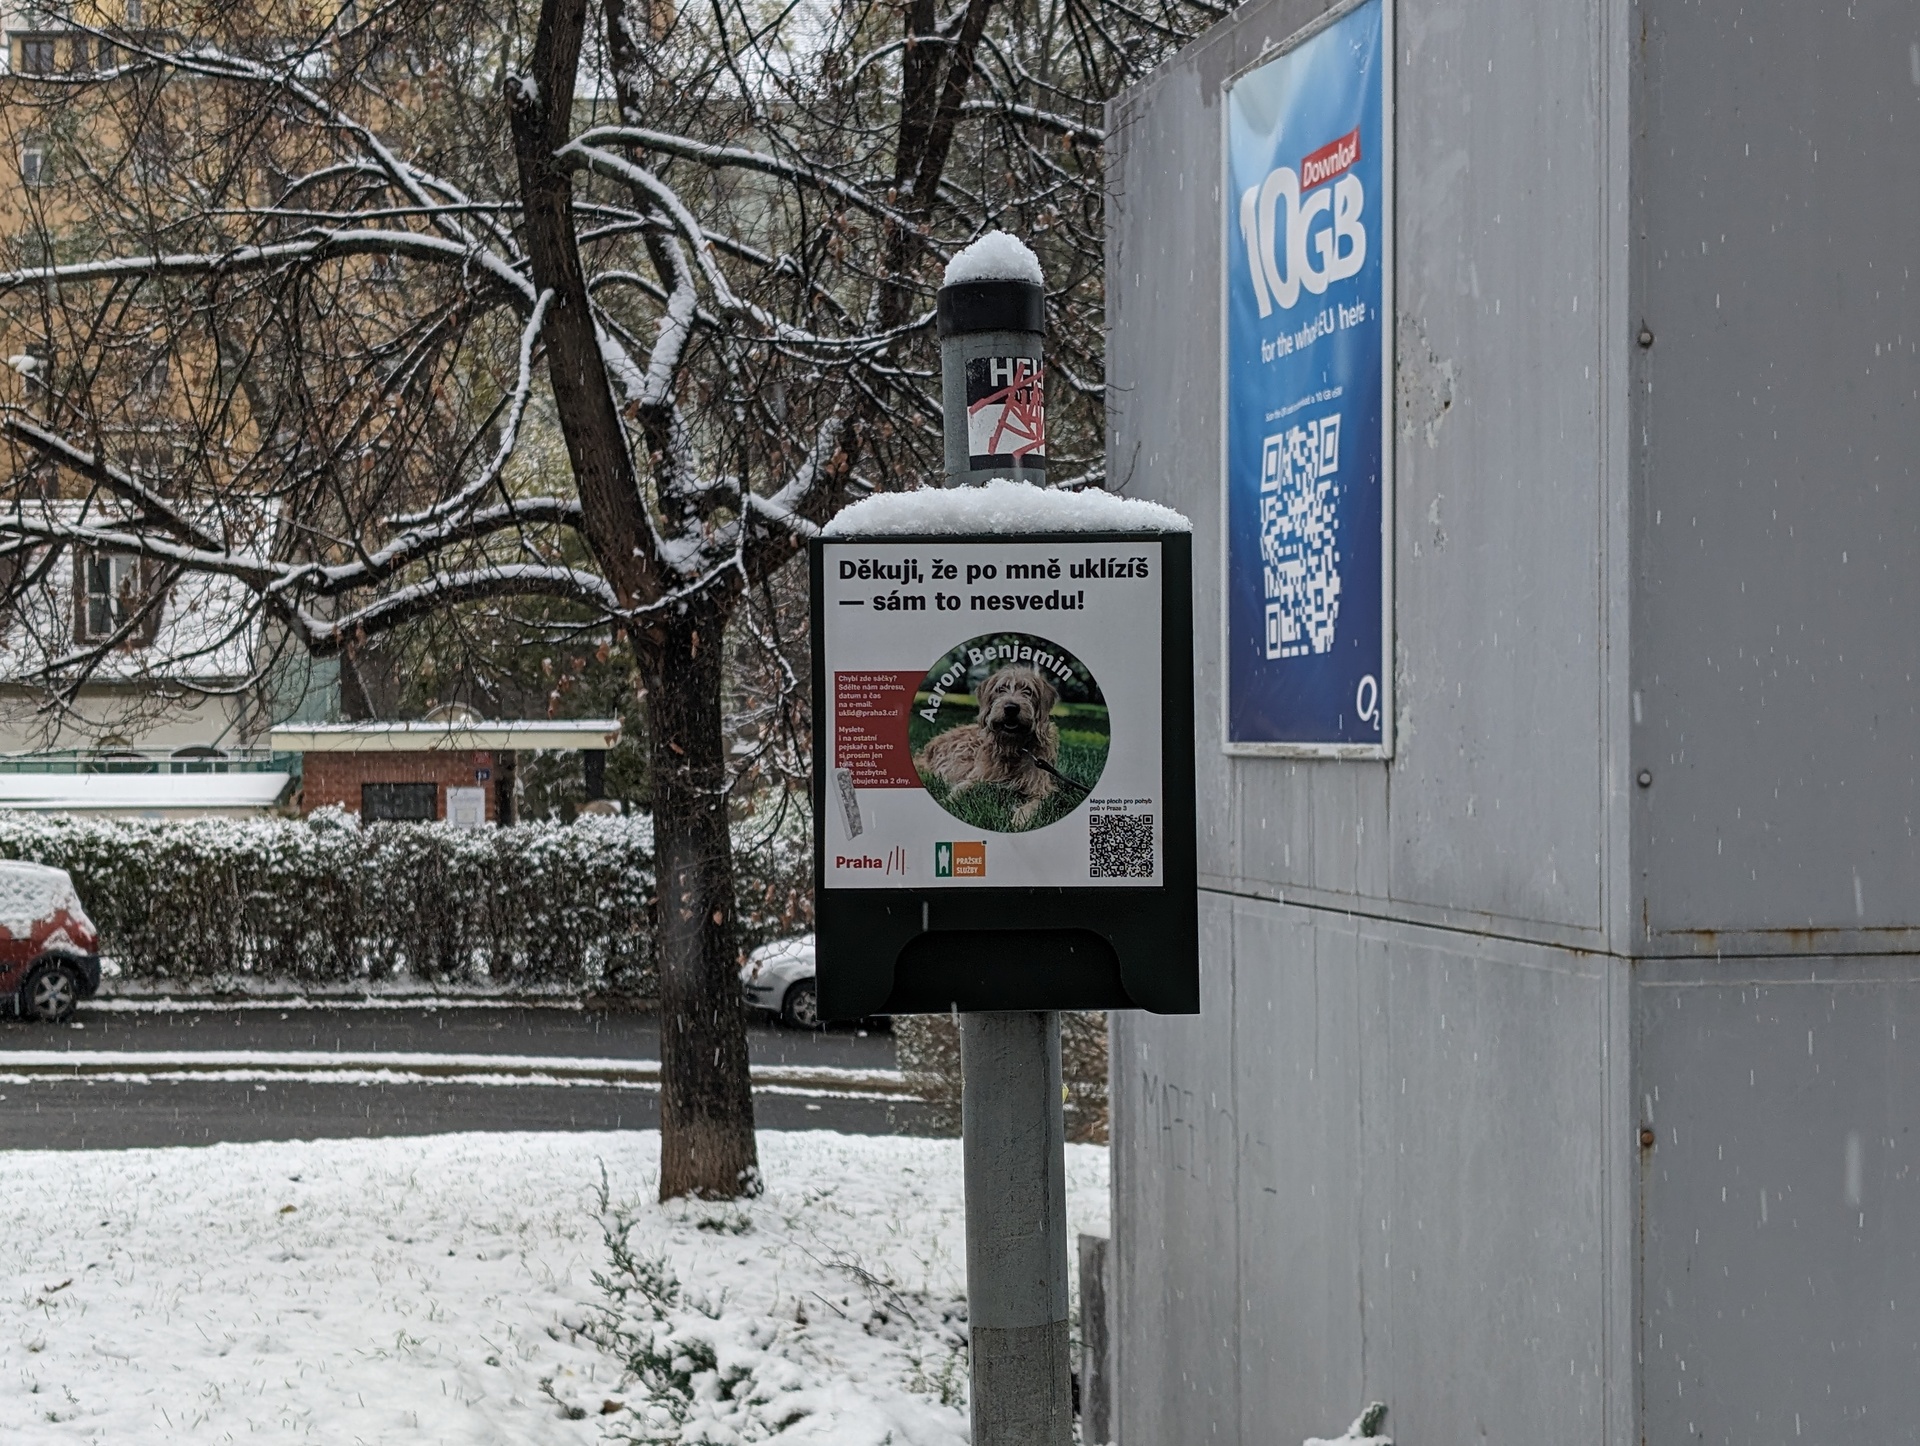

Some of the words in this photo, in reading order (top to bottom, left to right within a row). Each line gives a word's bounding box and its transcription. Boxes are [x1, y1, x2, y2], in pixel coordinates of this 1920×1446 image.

[1261, 338, 1275, 364] for
[1277, 331, 1293, 358] the
[1318, 306, 1335, 337] EU
[840, 559, 924, 584] Děkuji,
[932, 559, 958, 580] že
[967, 564, 998, 584] po
[1006, 558, 1061, 579] mně
[1070, 557, 1149, 580] uklízíš
[873, 590, 926, 611] sám
[935, 593, 961, 611] to
[970, 590, 1085, 611] nesvedu!
[838, 675, 858, 683] Chybí
[873, 675, 898, 683] sáčky?
[919, 661, 967, 724] Aaron
[968, 640, 1073, 682] Benjamin
[839, 726, 864, 734] Myslete
[839, 743, 867, 751] pejskaře
[856, 769, 887, 777] nezbytně
[836, 856, 883, 869] Praha
[956, 856, 982, 864] PRAŽSKÉ
[956, 866, 978, 874] SLUŽBY
